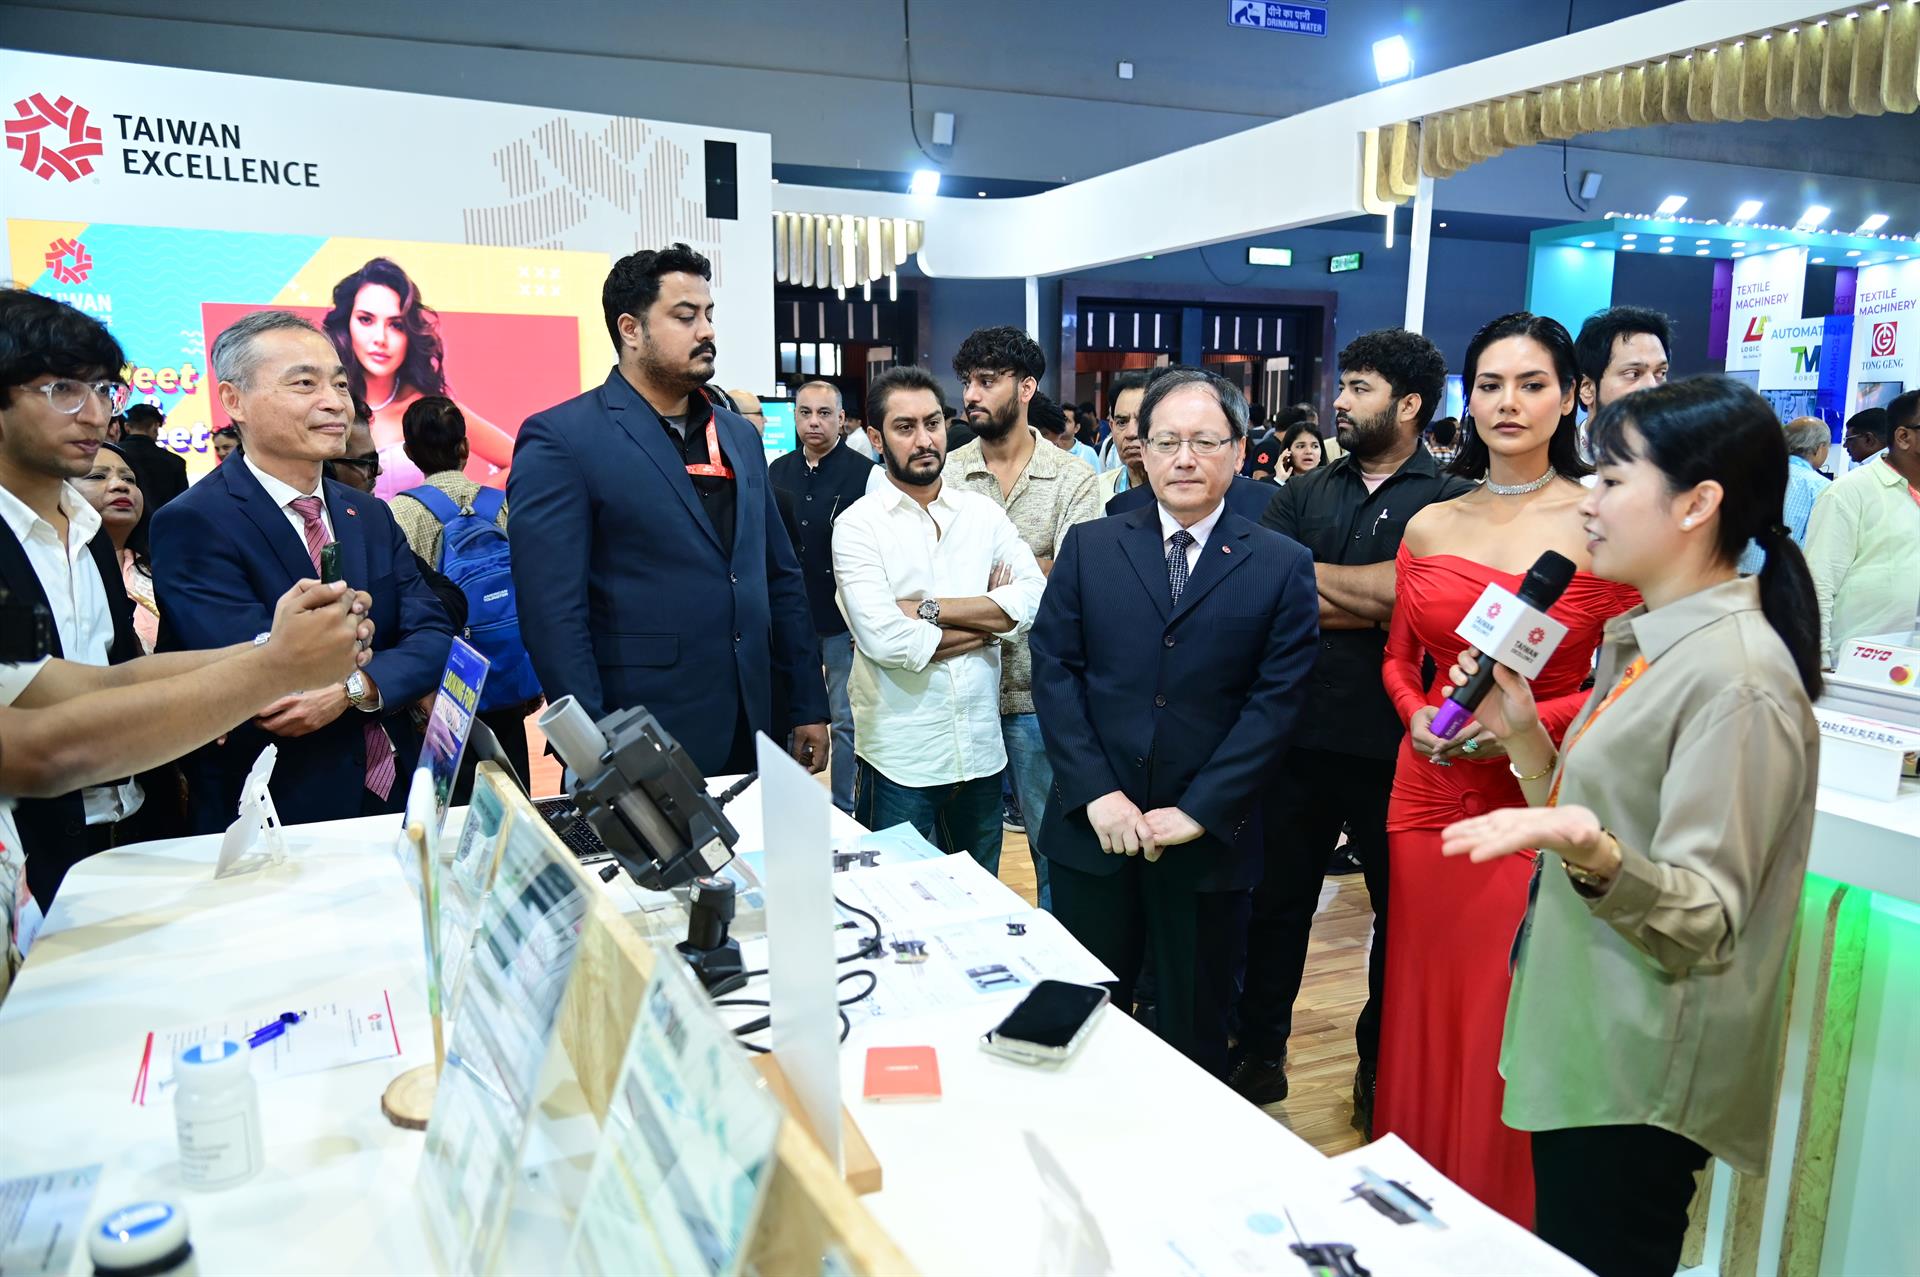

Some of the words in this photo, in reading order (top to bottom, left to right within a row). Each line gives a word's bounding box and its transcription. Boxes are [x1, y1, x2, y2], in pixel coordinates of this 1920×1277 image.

[1267, 5, 1281, 17] पीने
[1283, 9, 1293, 19] का
[1295, 9, 1311, 21] पानी
[1266, 17, 1298, 29] DRINKING
[1300, 22, 1322, 32] WATER
[113, 114, 241, 149] TAIWAN
[122, 148, 320, 187] EXCELLENCE
[1736, 281, 1771, 296] TEXTILE
[1860, 288, 1897, 303] TEXTILE
[1735, 293, 1789, 310] MACHINERY
[1859, 299, 1917, 316] MACHINERY
[1771, 323, 1847, 340] AUTOMATION
[1790, 344, 1822, 374] TM
[1862, 360, 1881, 370] TONG
[1882, 358, 1904, 369] GENG
[1515, 640, 1539, 658] TAIWAN
[1853, 646, 1893, 661] TOYO
